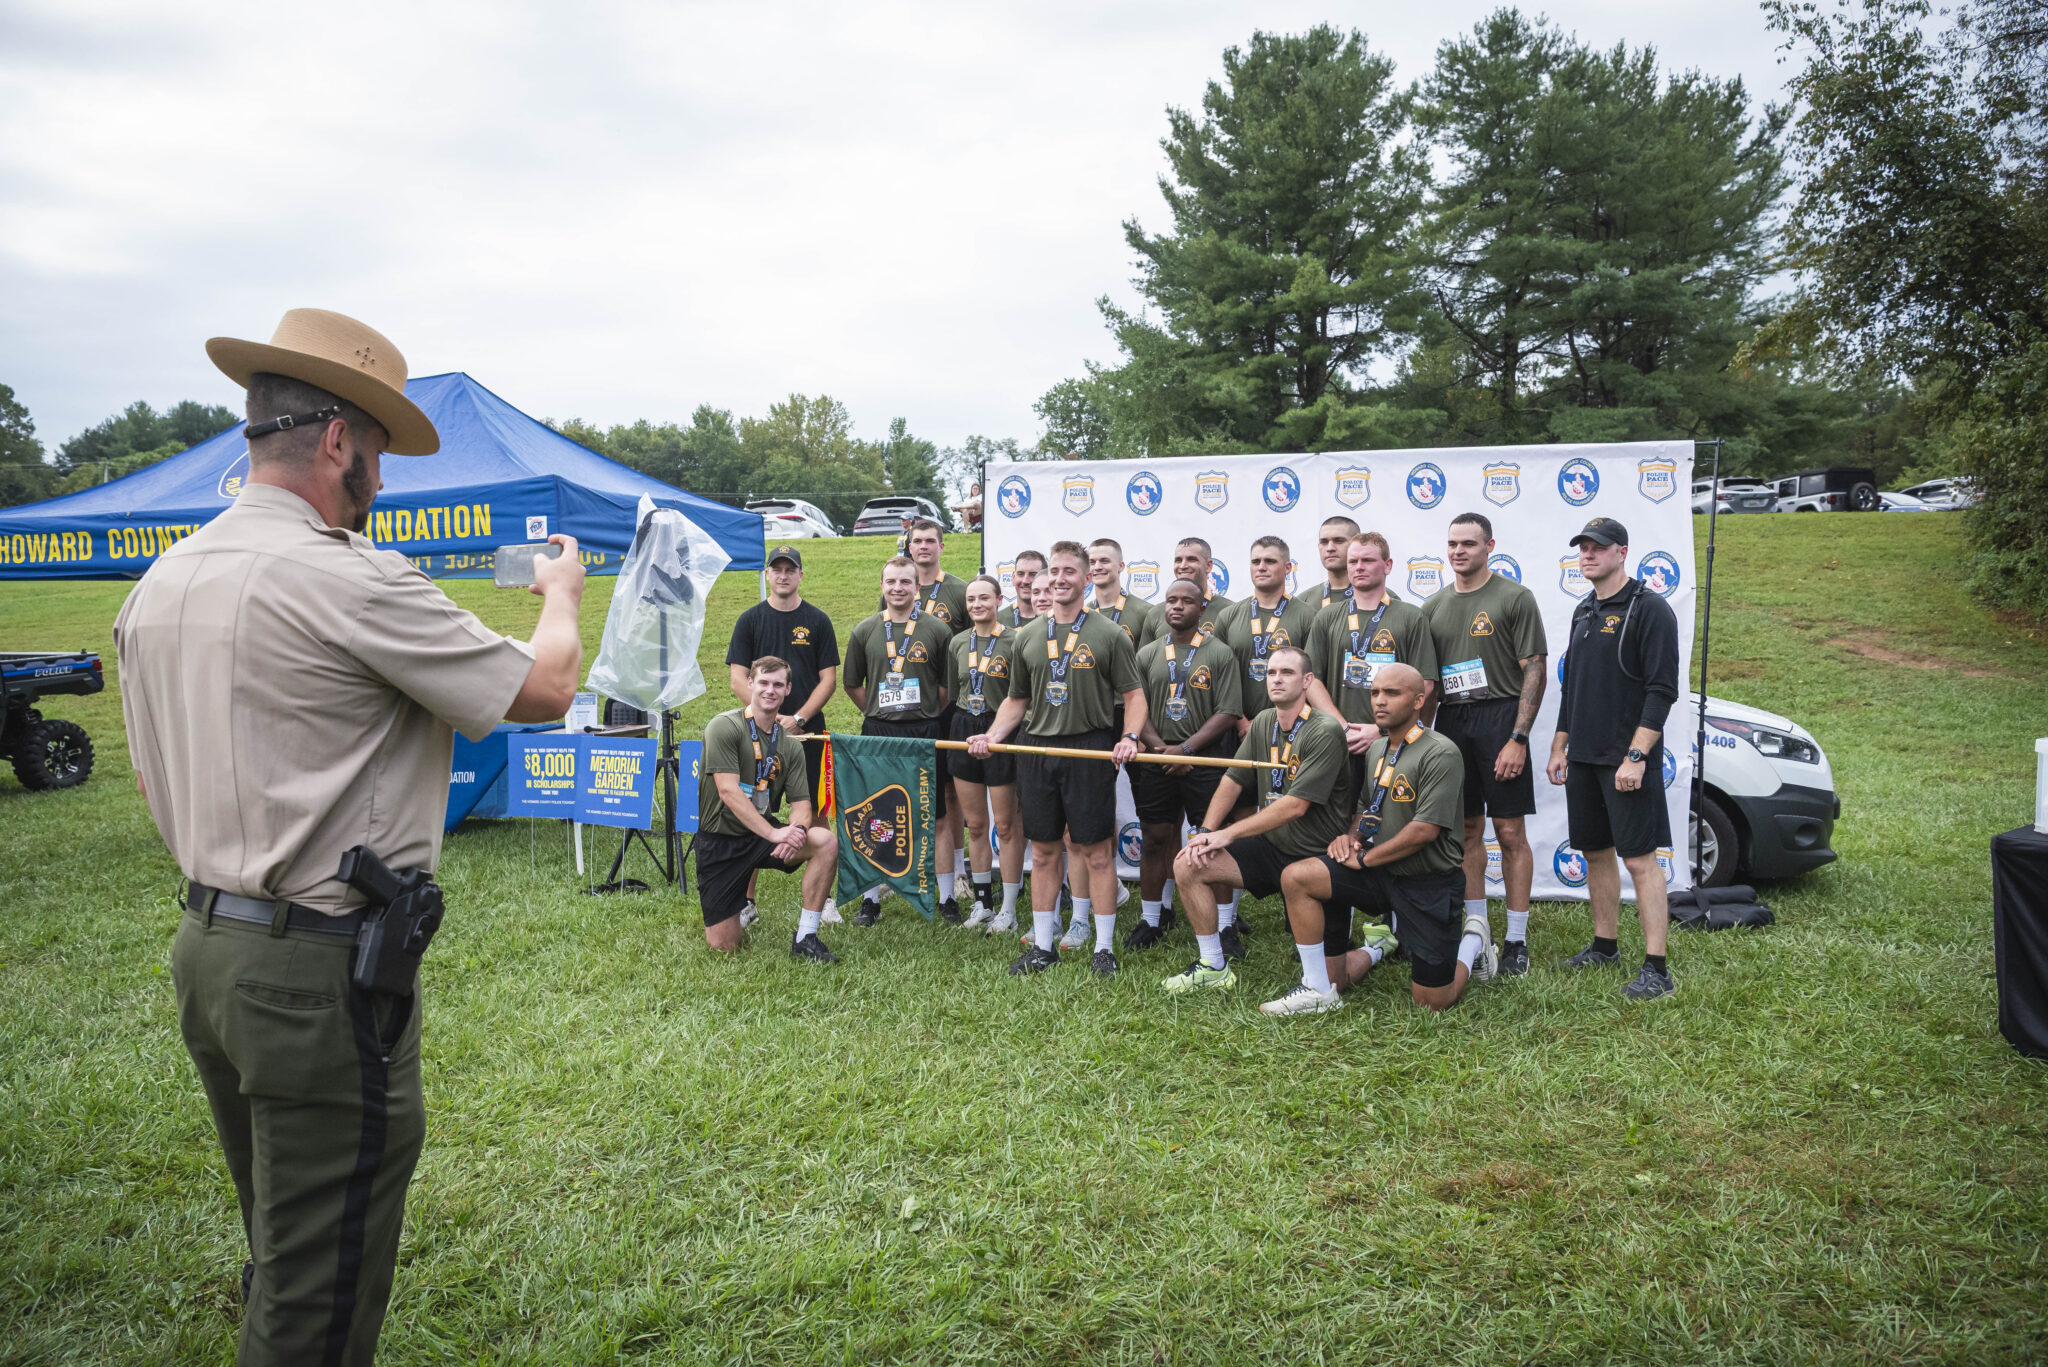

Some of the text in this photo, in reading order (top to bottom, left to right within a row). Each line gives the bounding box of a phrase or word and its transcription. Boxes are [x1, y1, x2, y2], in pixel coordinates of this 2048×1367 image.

[0, 531, 93, 564] HOWARD
[35, 666, 73, 677] POLICE
[1443, 675, 1464, 690] 2581
[880, 690, 902, 704] 2579
[525, 753, 575, 781] $8,000
[590, 756, 642, 774] MEMORIAL
[526, 780, 575, 789] IN SCHOLARSHIPS
[595, 772, 634, 790] GARDEN
[853, 803, 873, 857] MARYLAND
[896, 805, 907, 857] POLICE
[917, 767, 930, 894] TRAINING ACADEMY
